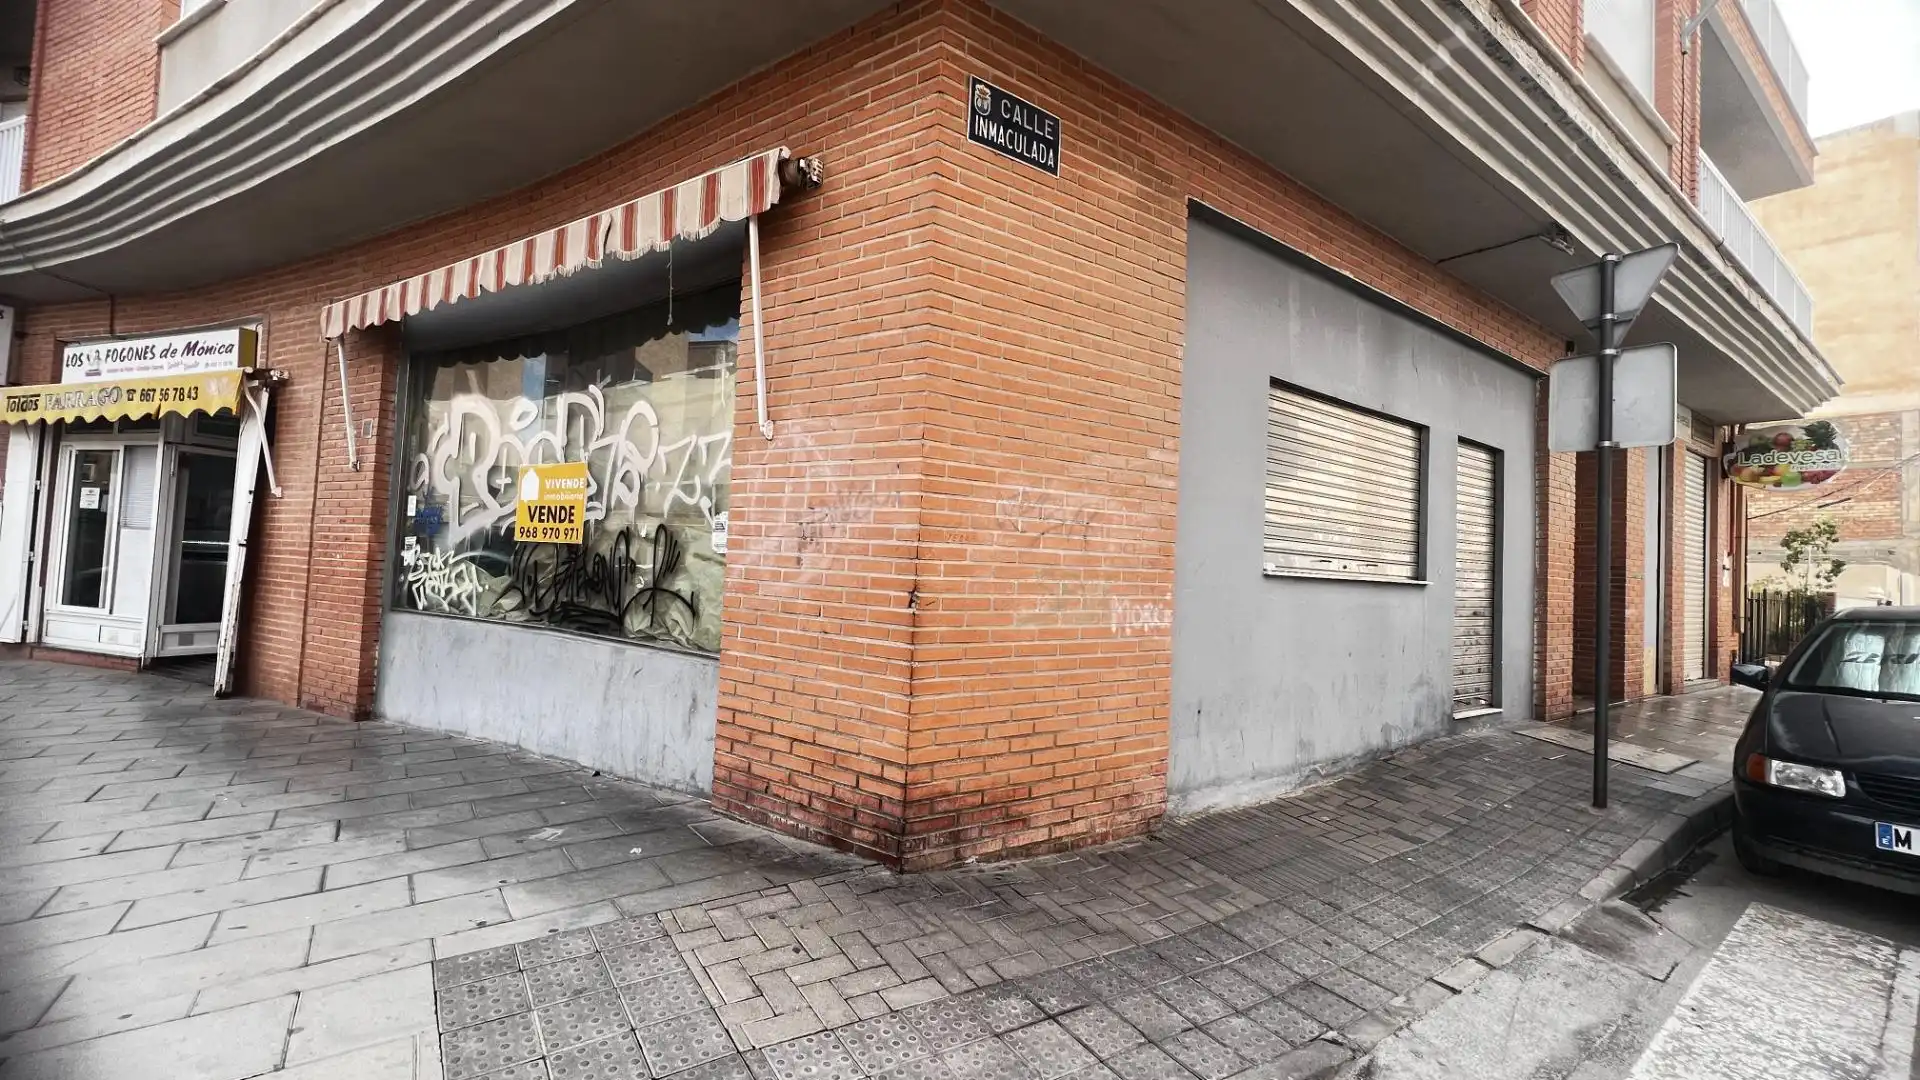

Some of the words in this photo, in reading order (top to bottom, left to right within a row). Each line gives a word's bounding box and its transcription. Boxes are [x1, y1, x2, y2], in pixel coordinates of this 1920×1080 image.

[1001, 99, 1054, 140] CALLE
[975, 115, 1055, 168] INMACULADA
[65, 352, 84, 368] LOS
[105, 344, 156, 364] FOGONES
[160, 342, 178, 359] de
[181, 339, 235, 358] Mónica
[6, 393, 41, 413] Toldos
[139, 388, 157, 402] 667
[159, 388, 170, 401] 56
[172, 387, 185, 401] 78
[186, 386, 199, 400] 43
[1738, 450, 1838, 465] Ladevesa
[545, 478, 585, 489] VIVENDE
[527, 505, 575, 524] VENDE
[519, 526, 538, 539] 968
[542, 527, 560, 540] 970
[563, 527, 580, 540] 971
[1894, 828, 1912, 850] M
